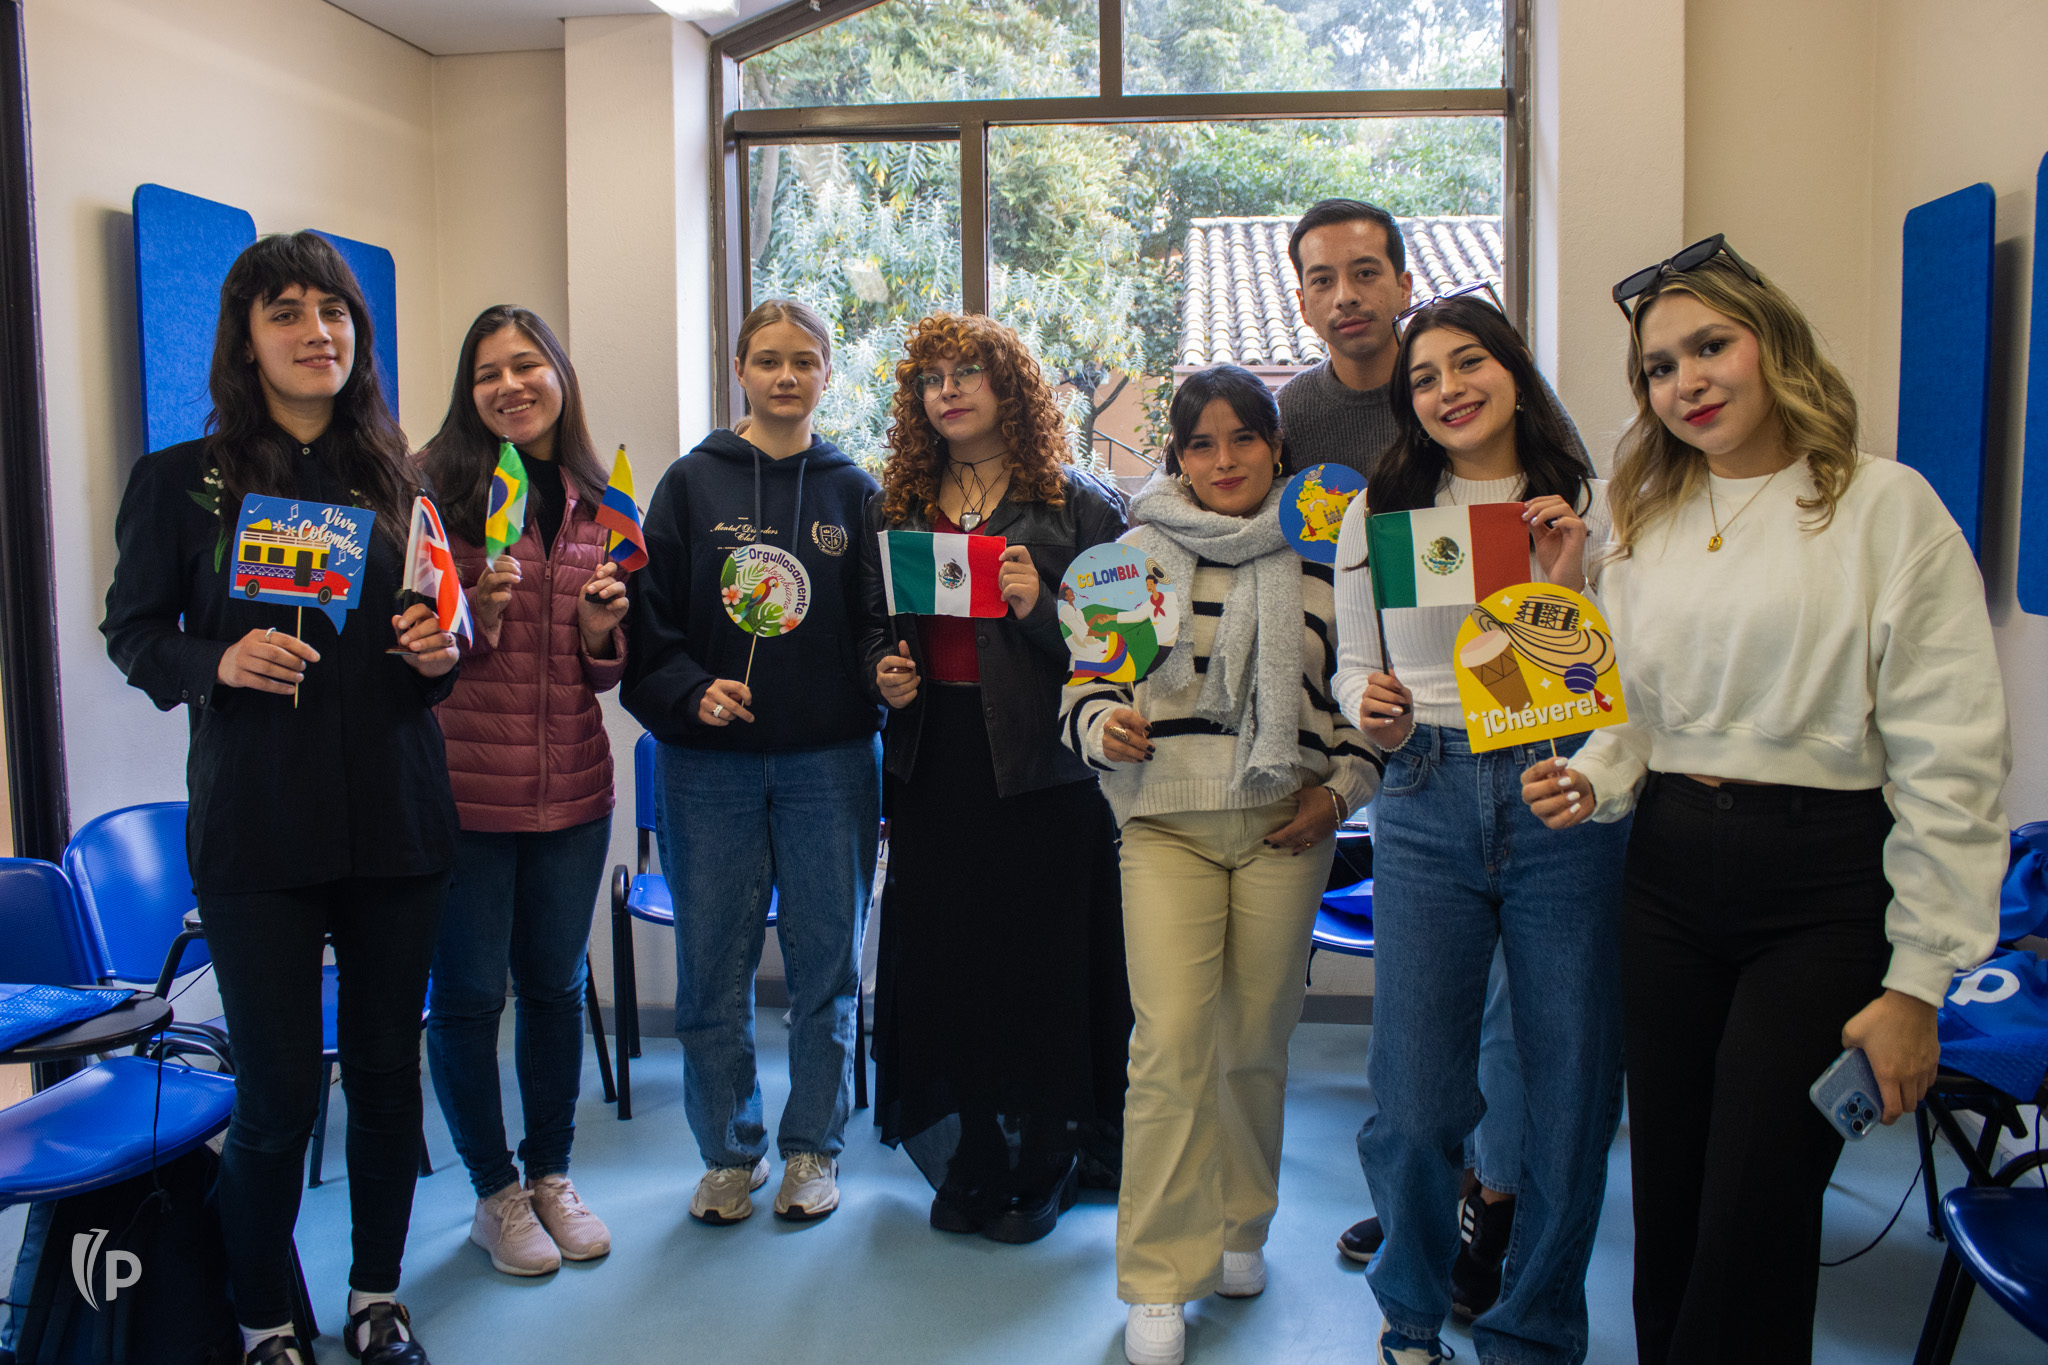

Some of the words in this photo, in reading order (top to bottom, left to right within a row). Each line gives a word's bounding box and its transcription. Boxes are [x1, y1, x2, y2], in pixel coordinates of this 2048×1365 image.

[321, 507, 358, 535] Viva
[709, 522, 741, 533] Mental
[742, 524, 779, 535] Disrders
[298, 519, 364, 560] Colombia
[749, 548, 808, 615] Orgullosamente
[1077, 563, 1140, 589] COLOMBIA
[1482, 690, 1600, 738] ¡Chévere!
